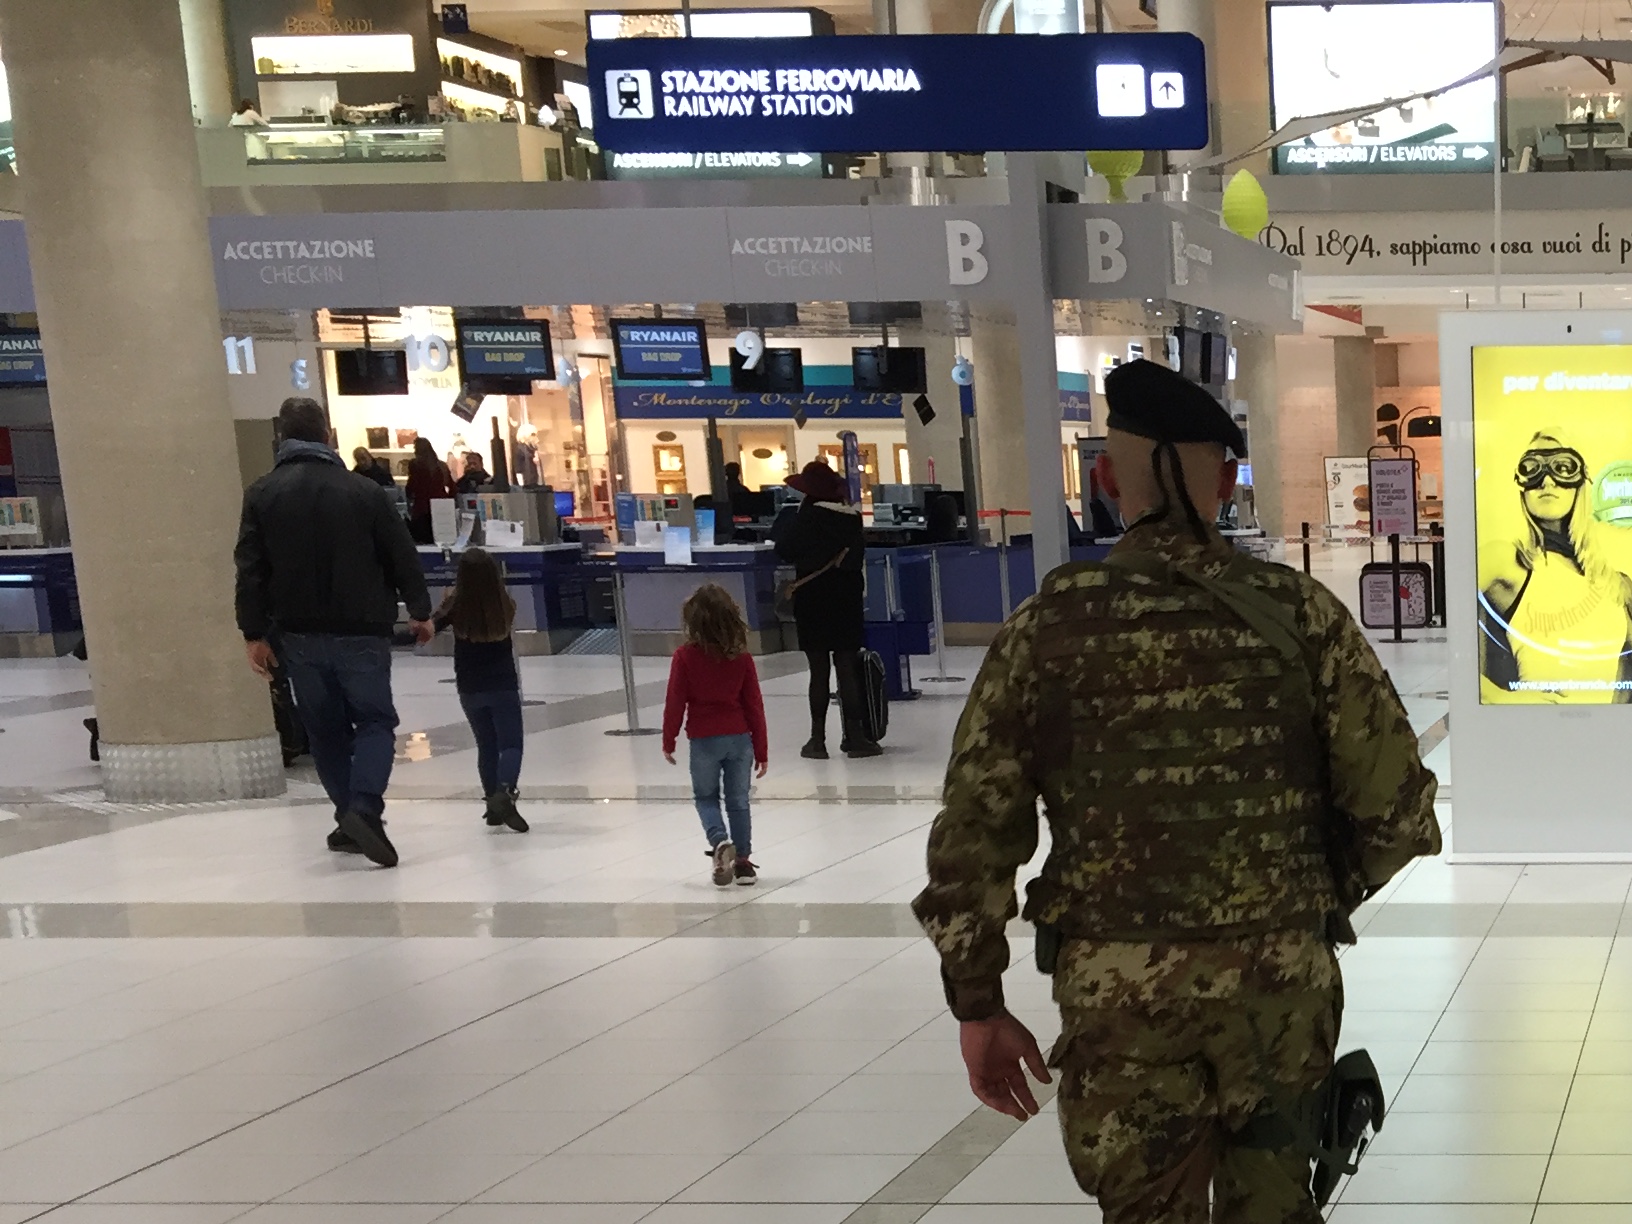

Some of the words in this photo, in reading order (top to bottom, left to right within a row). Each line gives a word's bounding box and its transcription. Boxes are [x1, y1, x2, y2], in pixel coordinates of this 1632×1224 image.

[285, 16, 373, 33] BERNARDI
[661, 69, 771, 93] STAZIONE
[775, 68, 921, 93] FERROVIARIA
[664, 95, 755, 117] RAILWAY
[761, 94, 853, 116] STATION
[705, 152, 781, 168] ELEVATORS
[1381, 145, 1457, 162] ELEVATORS
[223, 239, 375, 261] ACCETTAZIONE
[732, 237, 873, 255] ACCETTAZIONE
[945, 220, 989, 285] B
[1085, 218, 1128, 284] B
[1258, 221, 1305, 256] Dal
[1390, 234, 1481, 266] sappiamo
[1542, 232, 1582, 254] vuoi
[1592, 222, 1611, 254] di
[260, 264, 343, 285] CHECK-IN
[764, 259, 842, 277] CHECK-IN
[474, 330, 542, 342] RYANAIR
[630, 330, 698, 342] RYANAIR
[222, 335, 257, 375] 11
[403, 333, 449, 372] 10
[735, 330, 763, 370] 9
[1503, 375, 1540, 395] per
[633, 392, 752, 415] Montevago
[760, 391, 852, 415] Orlogi
